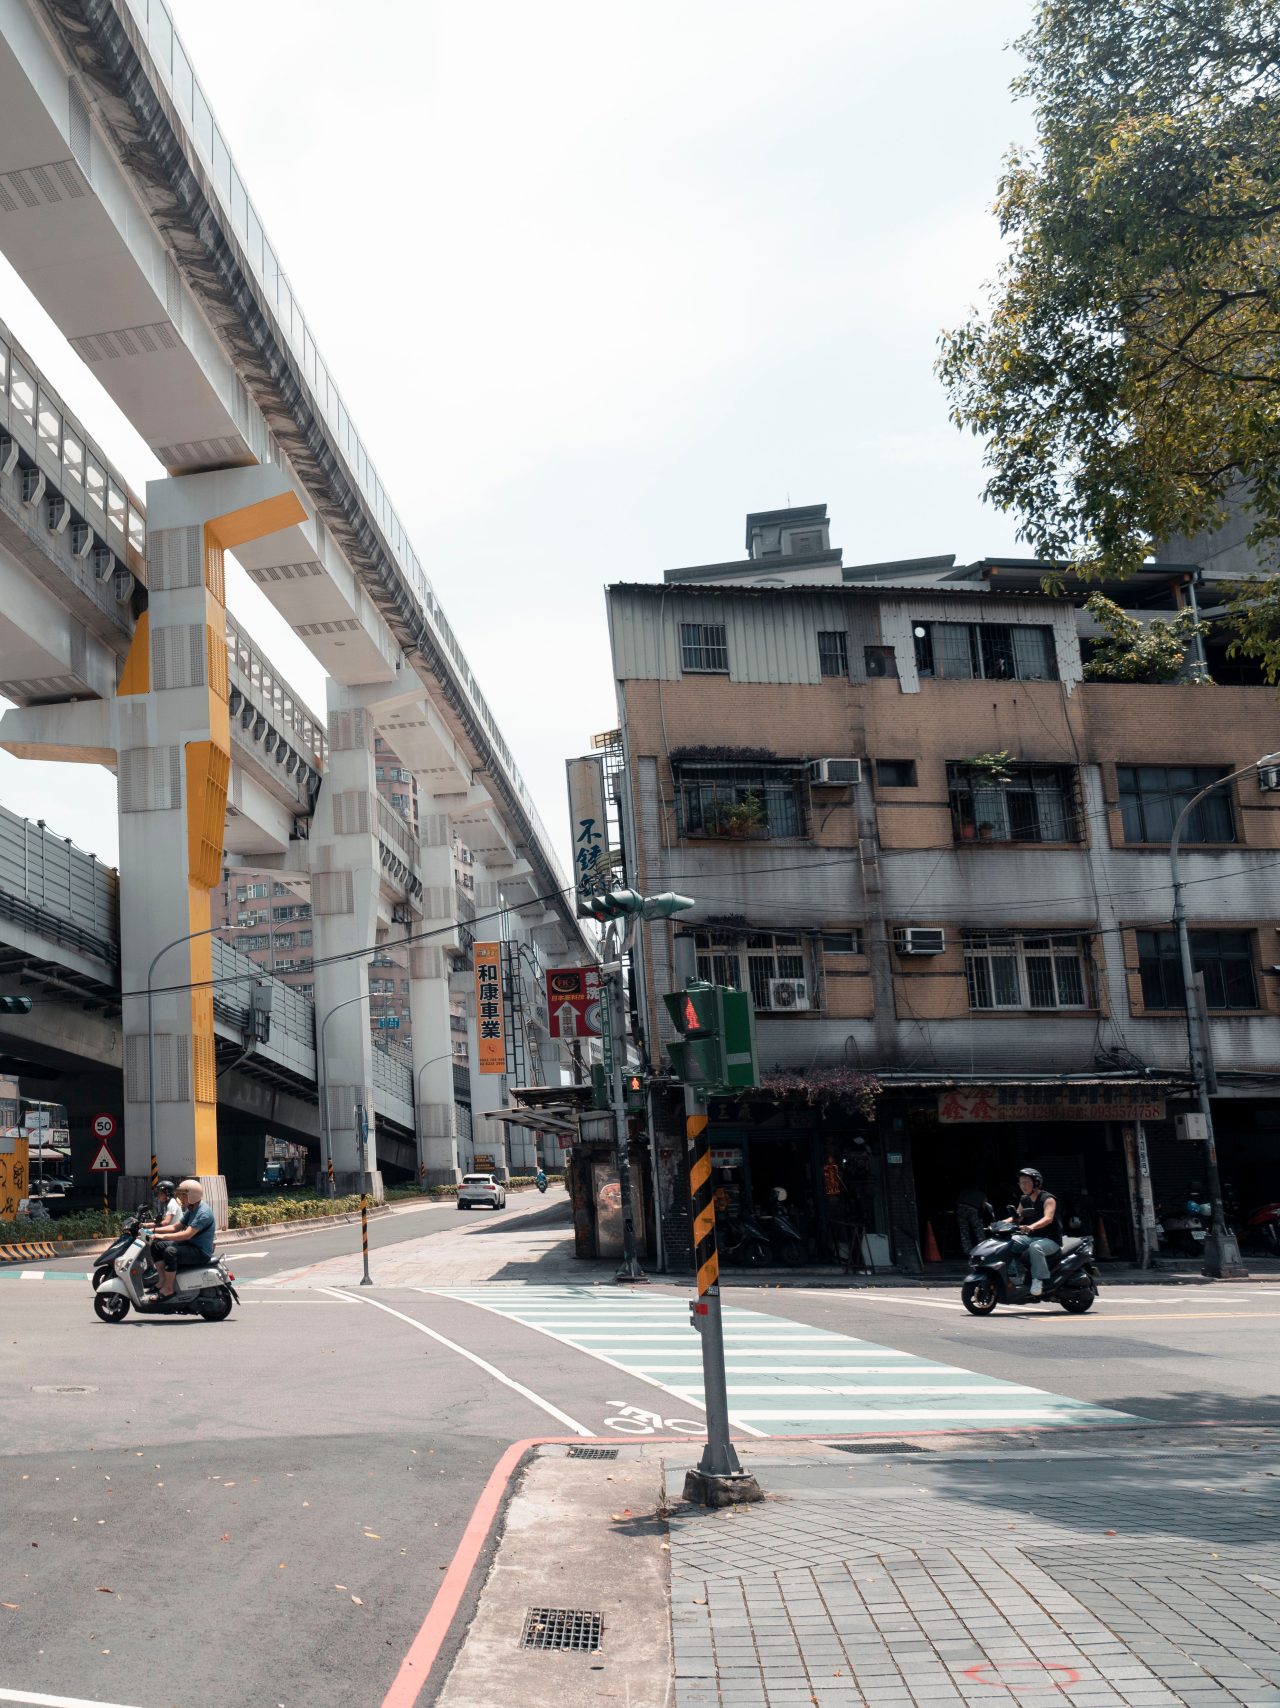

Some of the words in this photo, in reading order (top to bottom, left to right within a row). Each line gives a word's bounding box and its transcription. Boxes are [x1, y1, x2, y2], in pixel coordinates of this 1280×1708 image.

[478, 964, 501, 1039] 和康車業
[96, 1121, 112, 1132] 50
